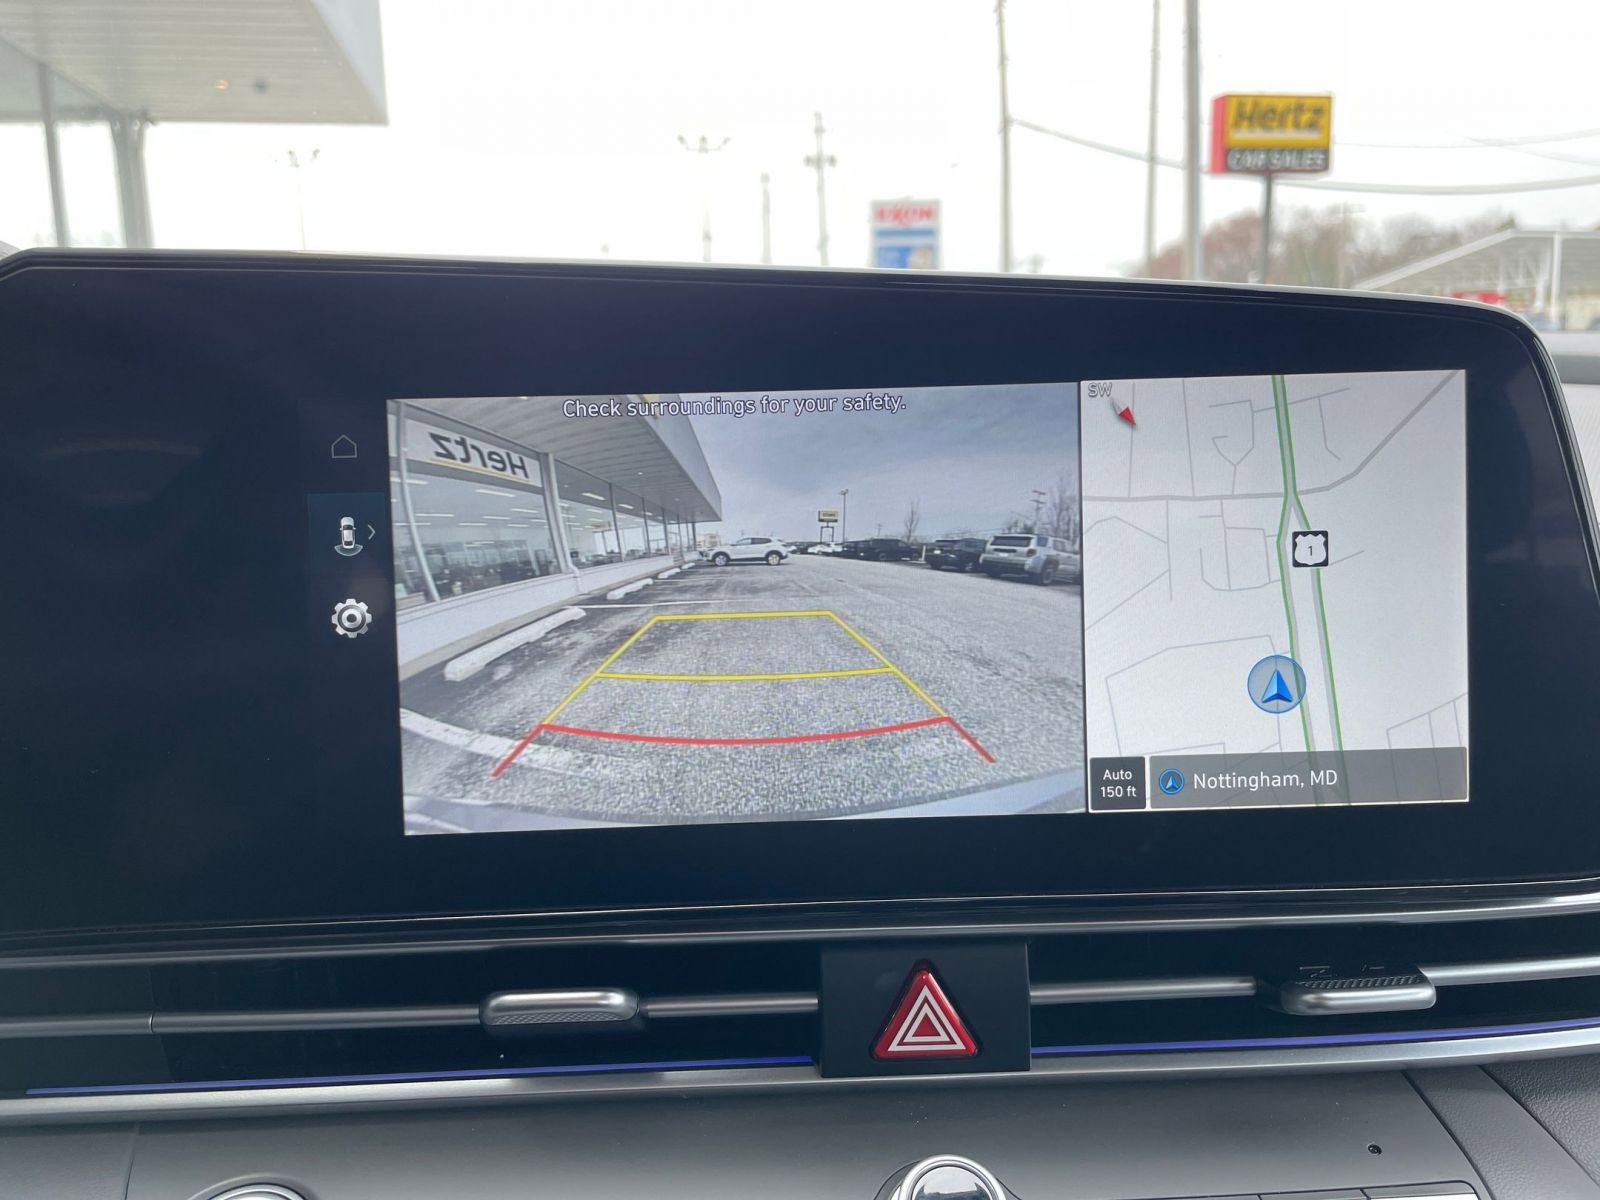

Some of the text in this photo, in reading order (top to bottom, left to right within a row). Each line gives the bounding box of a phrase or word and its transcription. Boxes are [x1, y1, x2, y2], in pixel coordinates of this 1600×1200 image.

[1231, 100, 1324, 131] Hertz
[1088, 382, 1112, 397] SW
[563, 393, 907, 418] Check surroundings for your safety.
[1307, 545, 1313, 557] 1
[1103, 769, 1132, 780] Auto
[1194, 770, 1338, 791] Nottingham, MD
[1100, 785, 1137, 798] 150 ft
